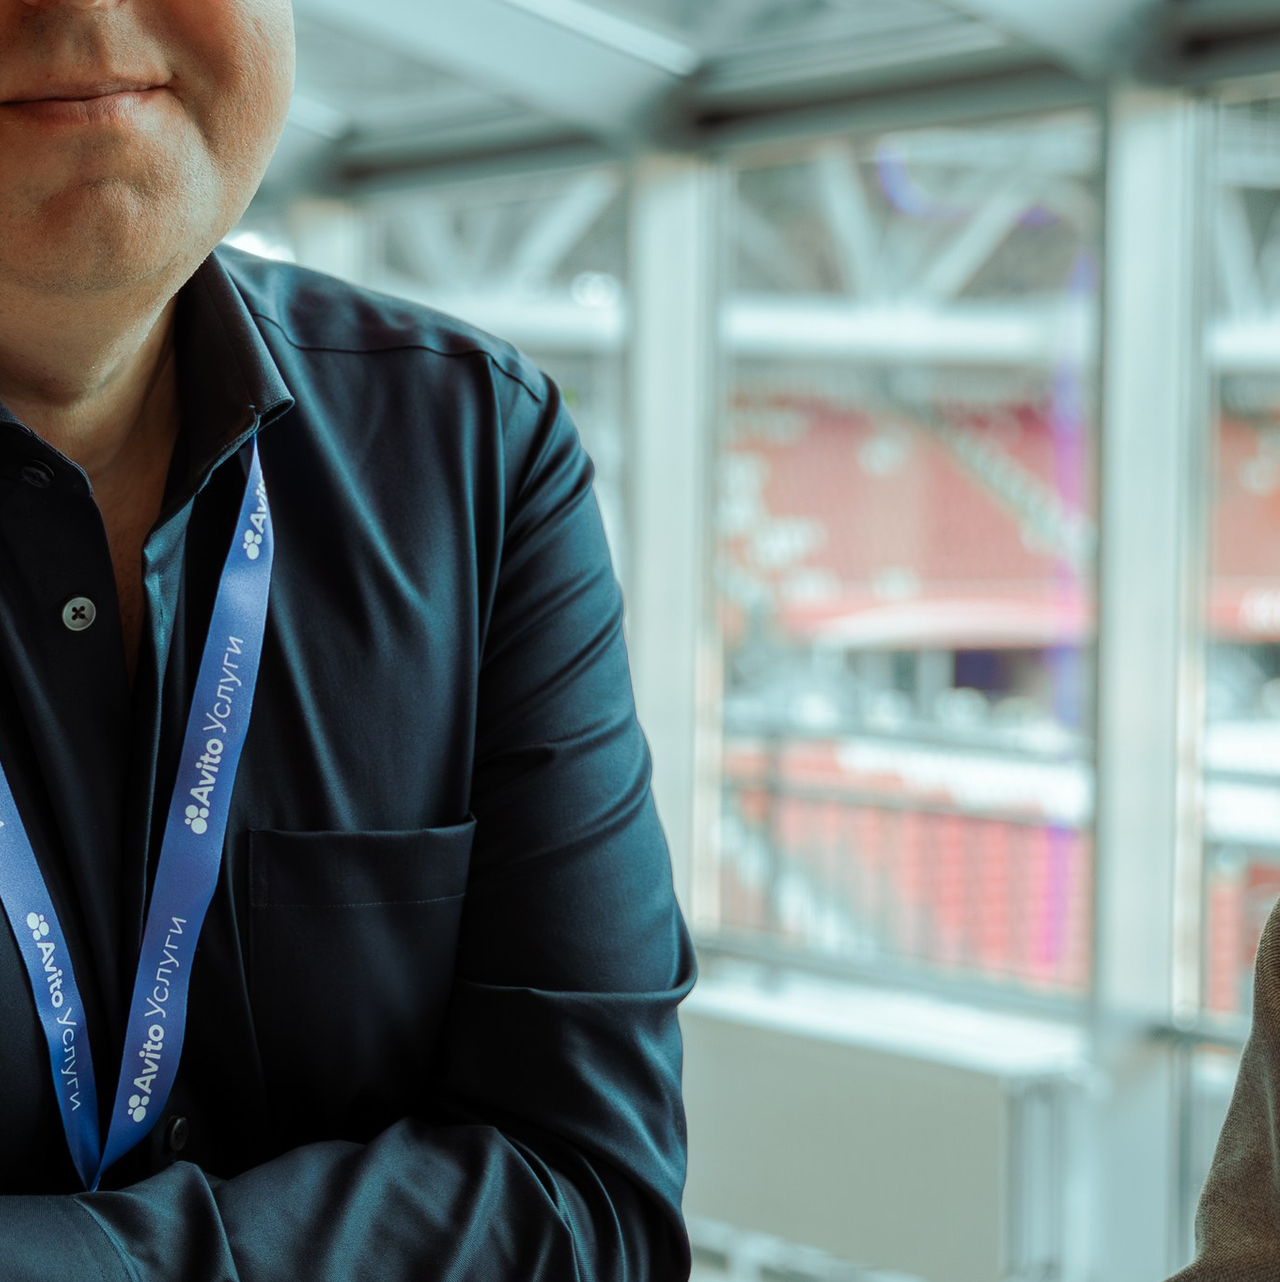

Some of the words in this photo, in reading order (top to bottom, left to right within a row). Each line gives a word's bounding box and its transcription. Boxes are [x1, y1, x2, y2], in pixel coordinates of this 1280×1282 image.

[203, 635, 244, 734] Услуги
[189, 738, 224, 808] Avito
[144, 916, 187, 1018] Услуги
[36, 942, 64, 1008] Avito
[56, 1006, 81, 1112] Услуги
[133, 1024, 165, 1095] Avito
